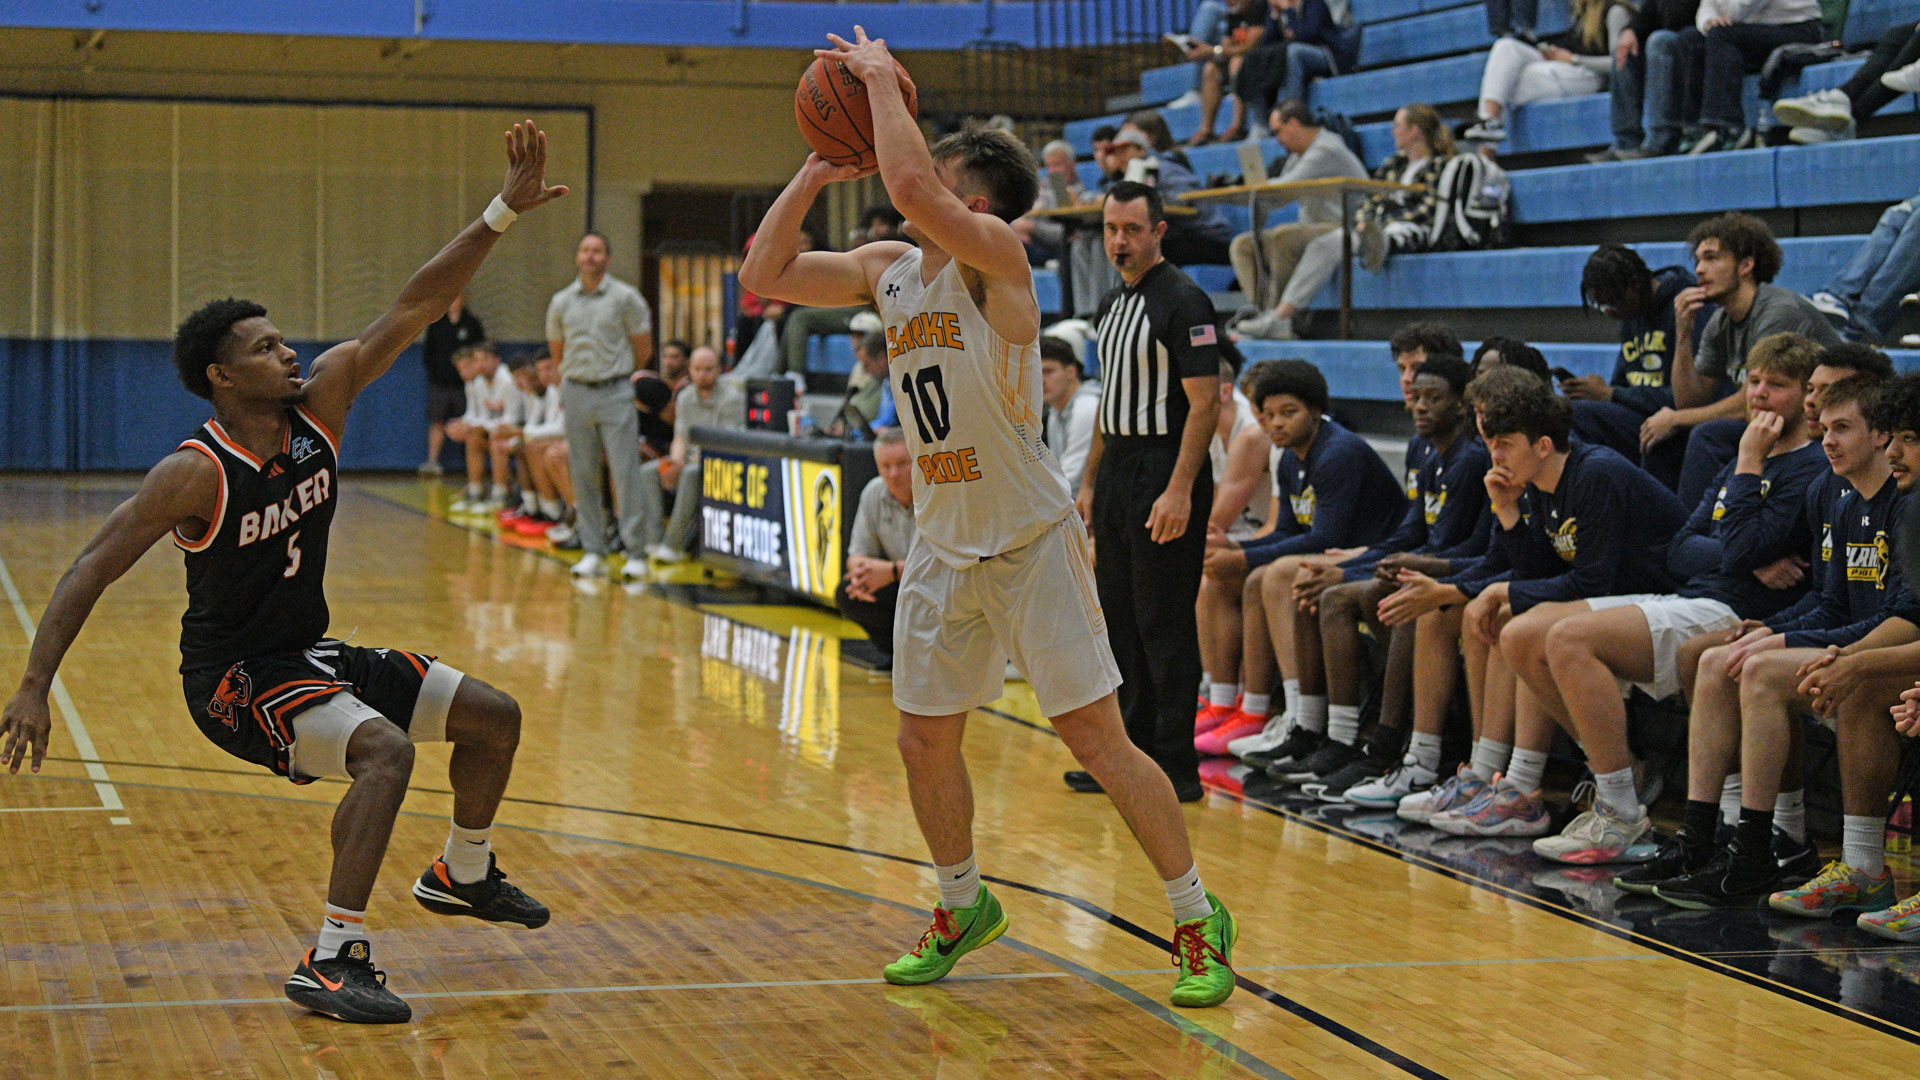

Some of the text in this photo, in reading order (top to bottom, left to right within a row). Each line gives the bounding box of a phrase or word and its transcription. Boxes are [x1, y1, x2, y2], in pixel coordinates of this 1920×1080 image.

[901, 364, 951, 444] 10
[238, 467, 330, 548] BAKER
[703, 457, 769, 510] HOME OF
[282, 529, 302, 578] 5
[702, 505, 782, 567] THE PRIDE
